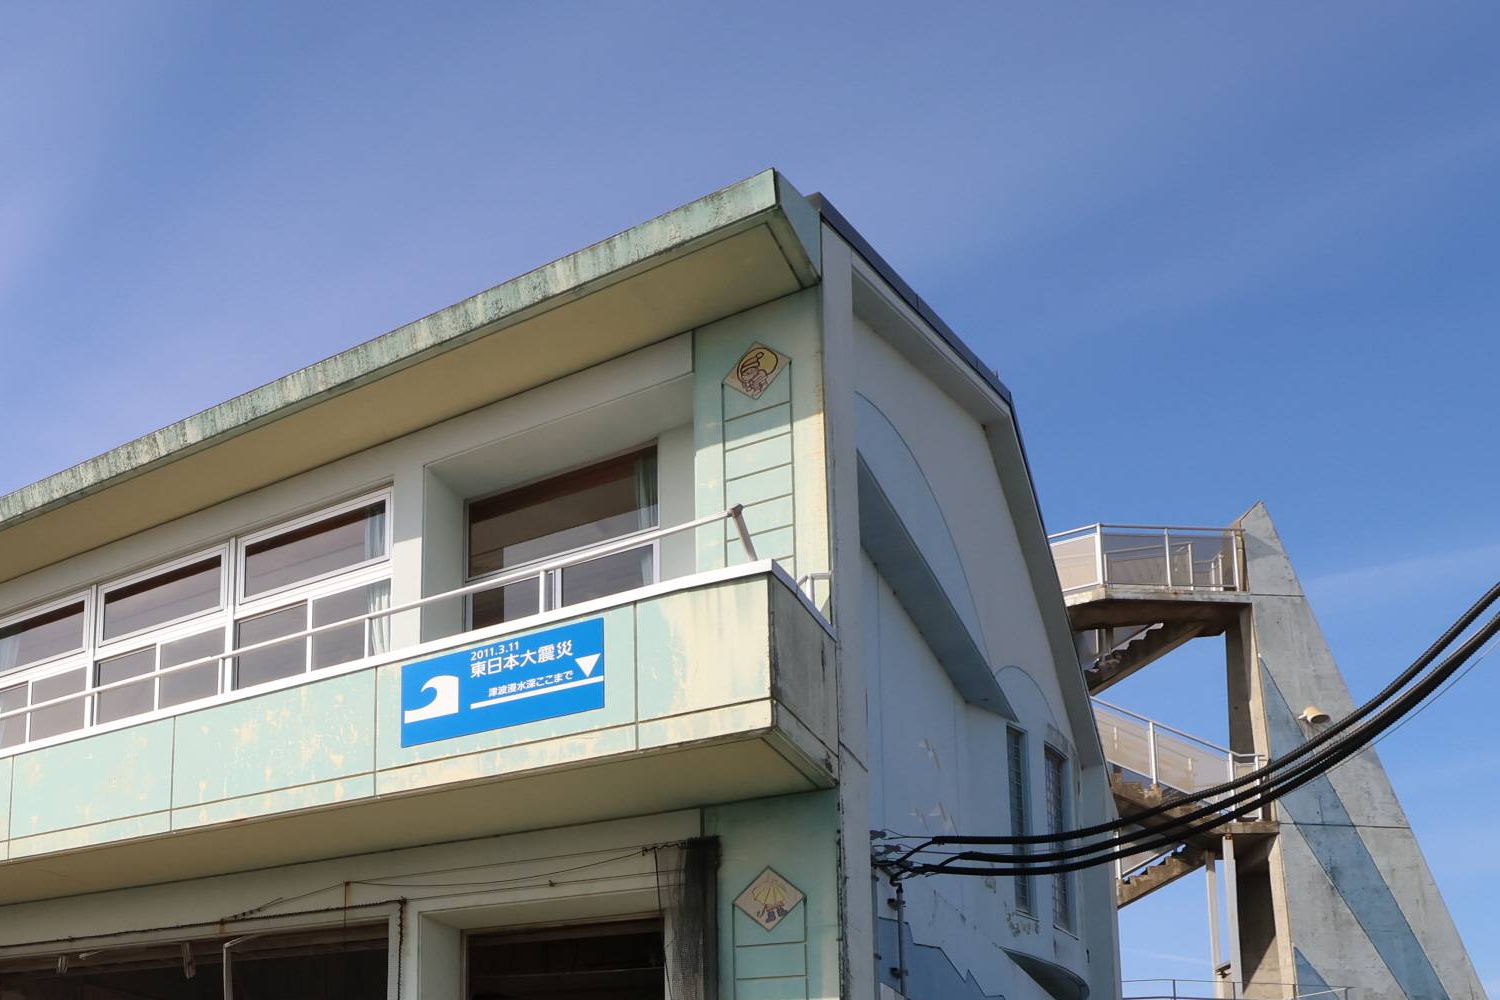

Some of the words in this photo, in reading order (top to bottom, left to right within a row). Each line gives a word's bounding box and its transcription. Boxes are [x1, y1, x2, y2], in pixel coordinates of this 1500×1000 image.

[470, 641, 519, 661] 2011.3.11
[470, 640, 573, 678] 東日本大震災
[488, 670, 573, 697] 津波浸水深ここまで
